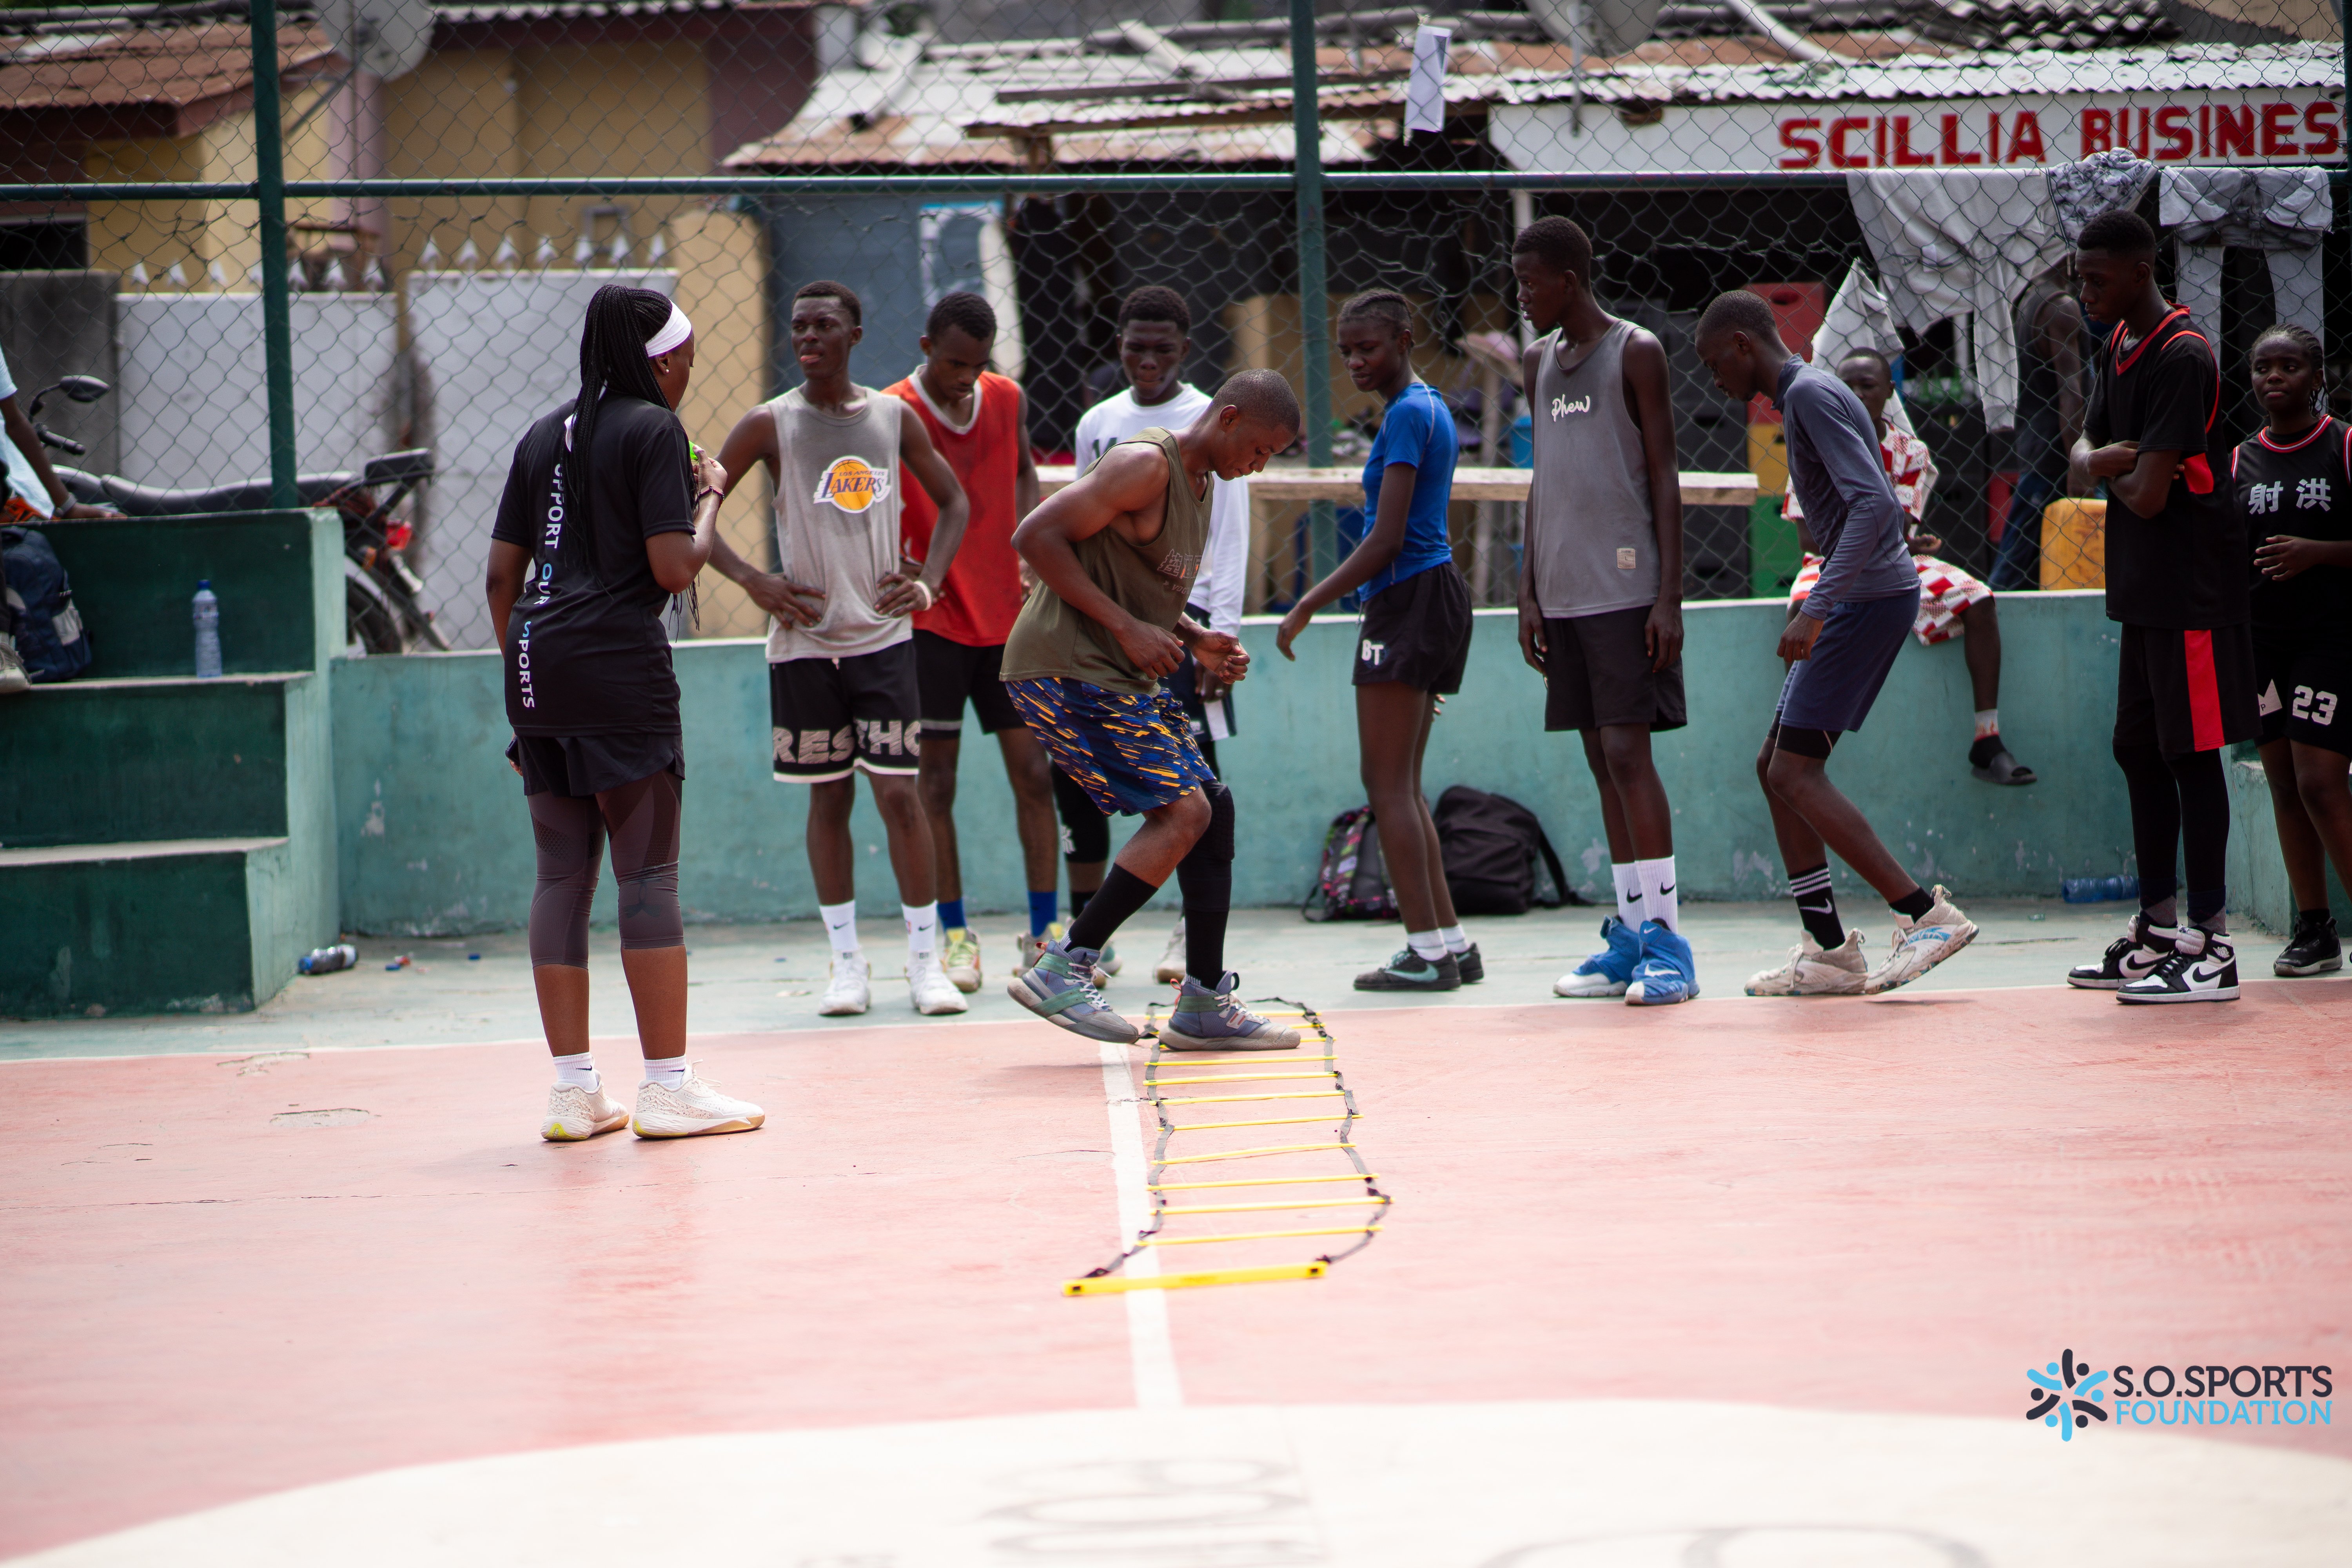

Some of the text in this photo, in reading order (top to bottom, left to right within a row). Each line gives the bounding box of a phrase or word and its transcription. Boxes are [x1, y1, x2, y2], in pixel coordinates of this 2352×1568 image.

[1778, 100, 2348, 168] SCILLIA BUSINES
[2248, 478, 2331, 515] 射洪
[519, 463, 564, 708] UPPORT OUR SPORTS
[1361, 639, 1384, 666] BT
[2292, 684, 2337, 726] 23
